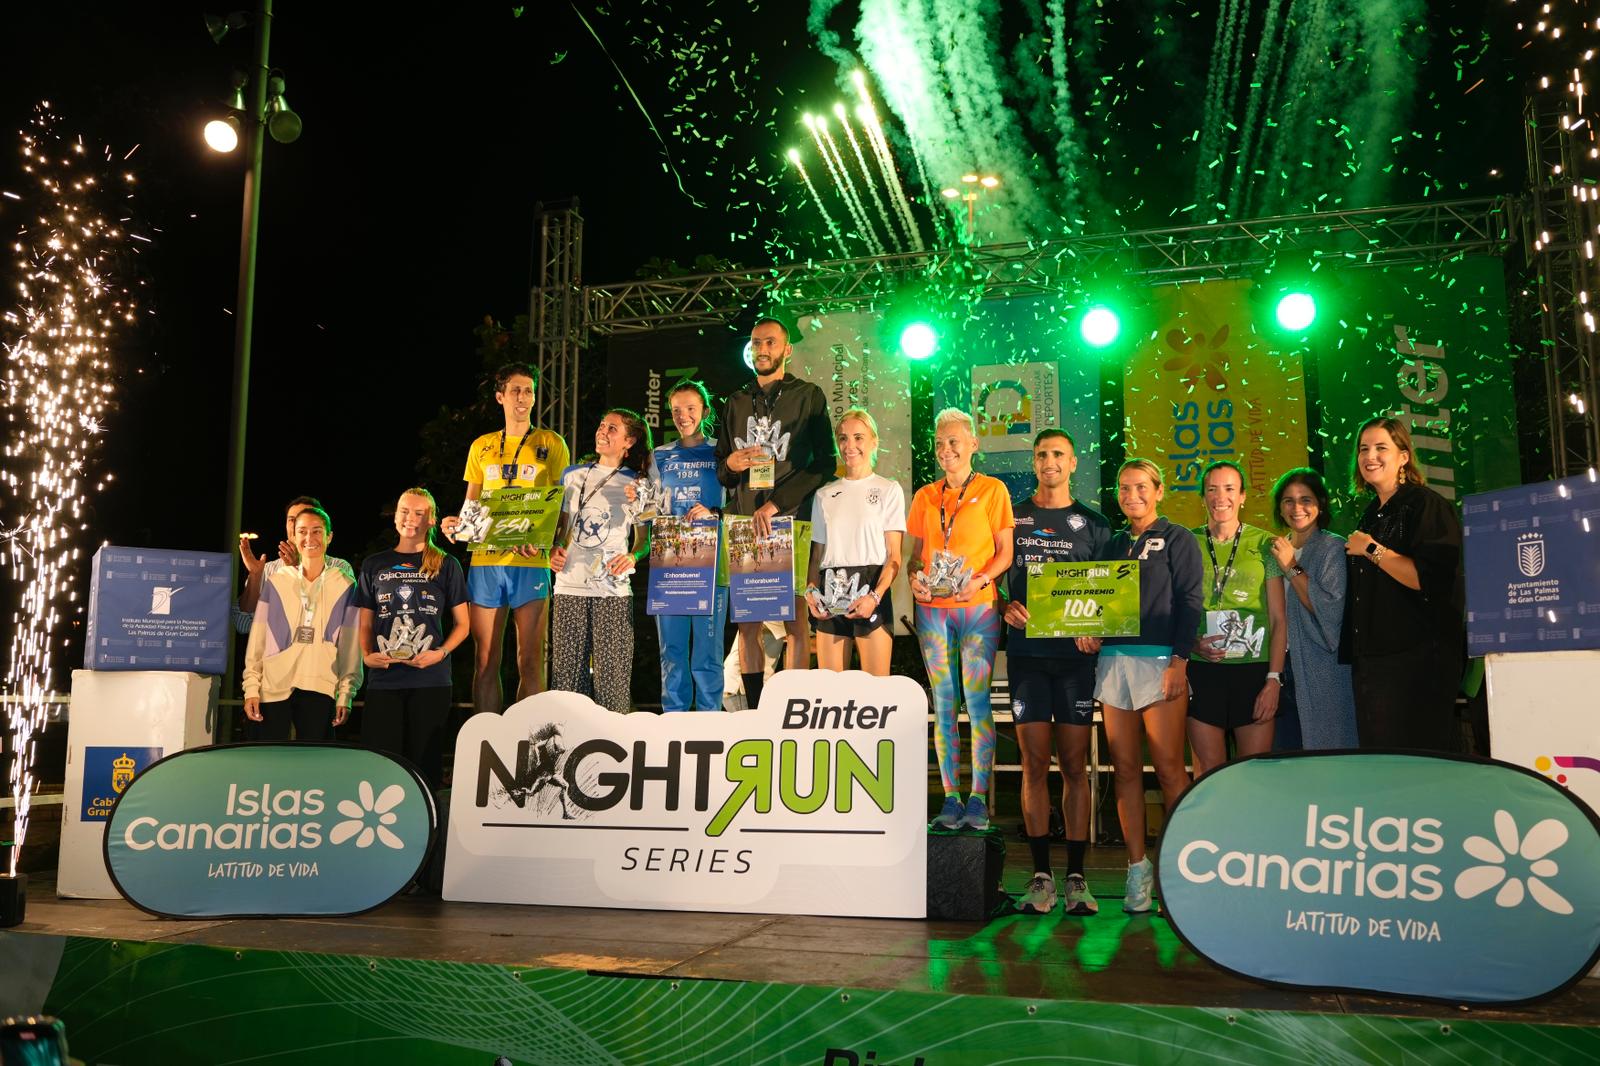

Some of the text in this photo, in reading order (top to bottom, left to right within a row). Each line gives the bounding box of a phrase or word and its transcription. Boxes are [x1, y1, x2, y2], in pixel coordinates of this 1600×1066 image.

[833, 343, 845, 402] Municipal
[645, 369, 660, 428] Binter
[1168, 401, 1201, 491] Islas
[683, 461, 716, 470] TENERIFE
[677, 470, 699, 479] 1984
[1016, 537, 1073, 549] CajaCanarias
[1025, 554, 1043, 562] DXT
[378, 571, 427, 582] CajaCanaria
[1508, 579, 1559, 590] Ayuntamiento
[1051, 589, 1082, 597] QUINTO
[1518, 595, 1534, 603] Gran
[1534, 594, 1560, 602] Canaria
[1519, 588, 1532, 596] Las
[1534, 587, 1559, 595] Palmas
[782, 698, 897, 730] Binter
[93, 797, 116, 807] Cabi
[226, 783, 325, 817] Islas
[124, 816, 323, 851] Canarias
[1305, 804, 1444, 854] Islas
[621, 847, 752, 874] SERIES
[268, 863, 285, 878] DE
[289, 862, 319, 878] VIDA
[1177, 840, 1443, 901] Canarias
[1368, 918, 1392, 938] DE
[1397, 918, 1441, 943] VIDA
